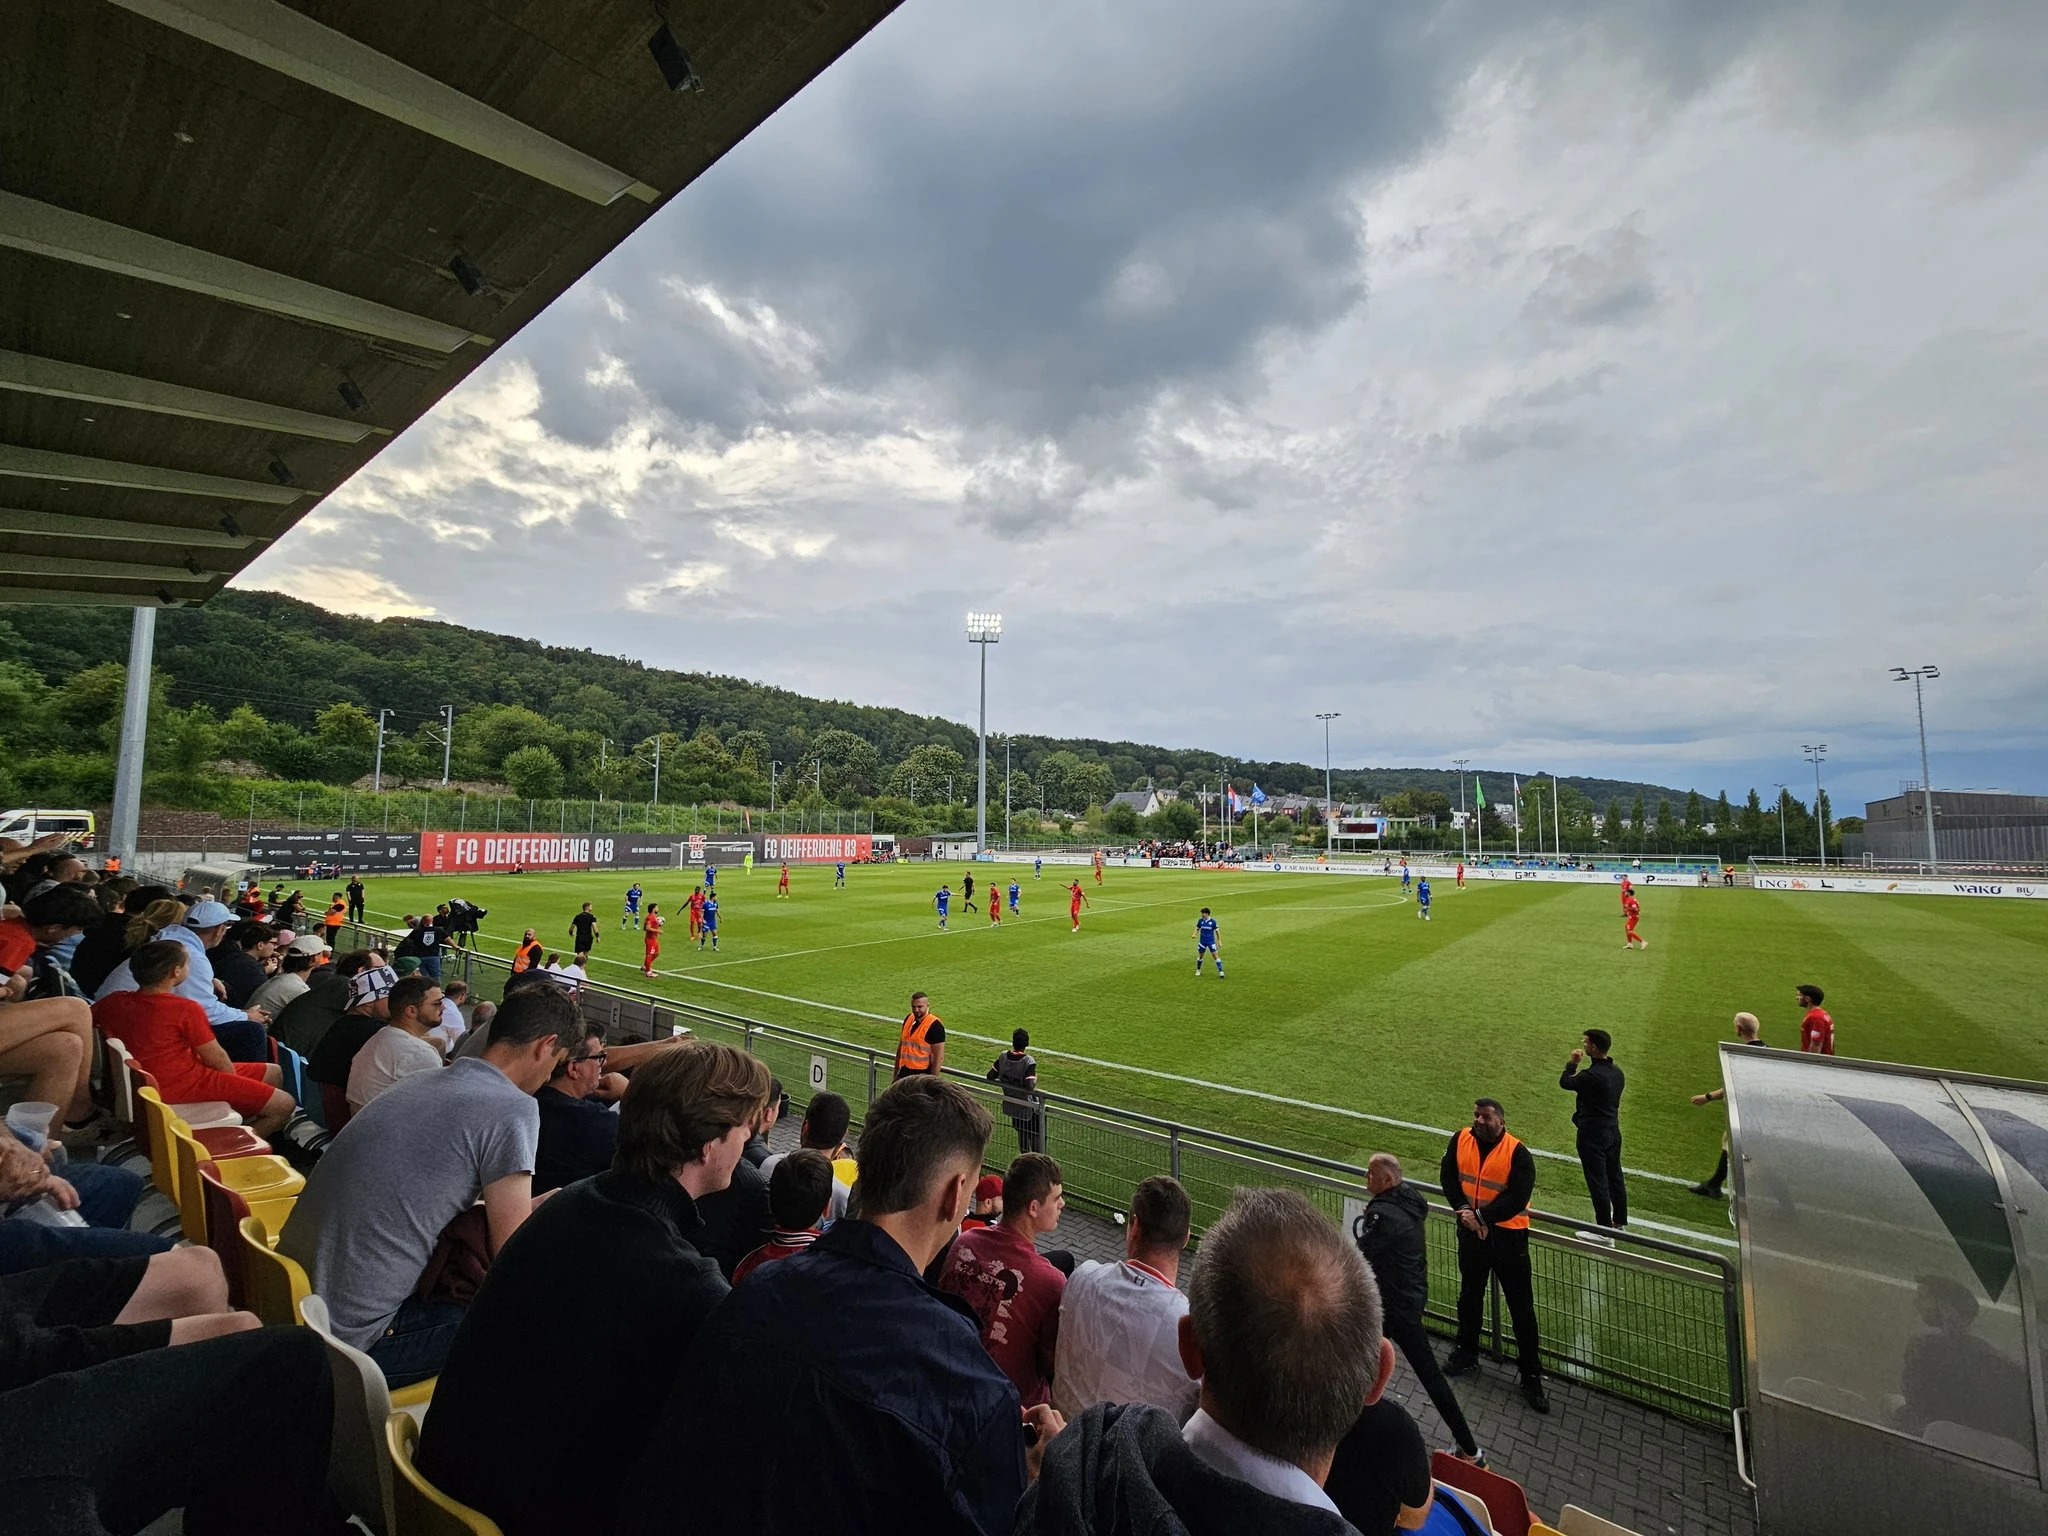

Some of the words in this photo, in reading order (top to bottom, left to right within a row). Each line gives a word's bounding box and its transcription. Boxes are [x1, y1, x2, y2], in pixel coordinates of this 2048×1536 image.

[455, 838, 479, 865] FC
[484, 838, 590, 864] DEIFFERDENG
[594, 838, 614, 862] 03
[690, 850, 704, 859] 03
[763, 838, 778, 859] FC
[780, 838, 842, 859] DEIFFERDENG
[844, 838, 857, 858] 03
[1759, 879, 1787, 888] ING
[2016, 886, 2031, 894] BIL
[813, 1064, 824, 1084] D
